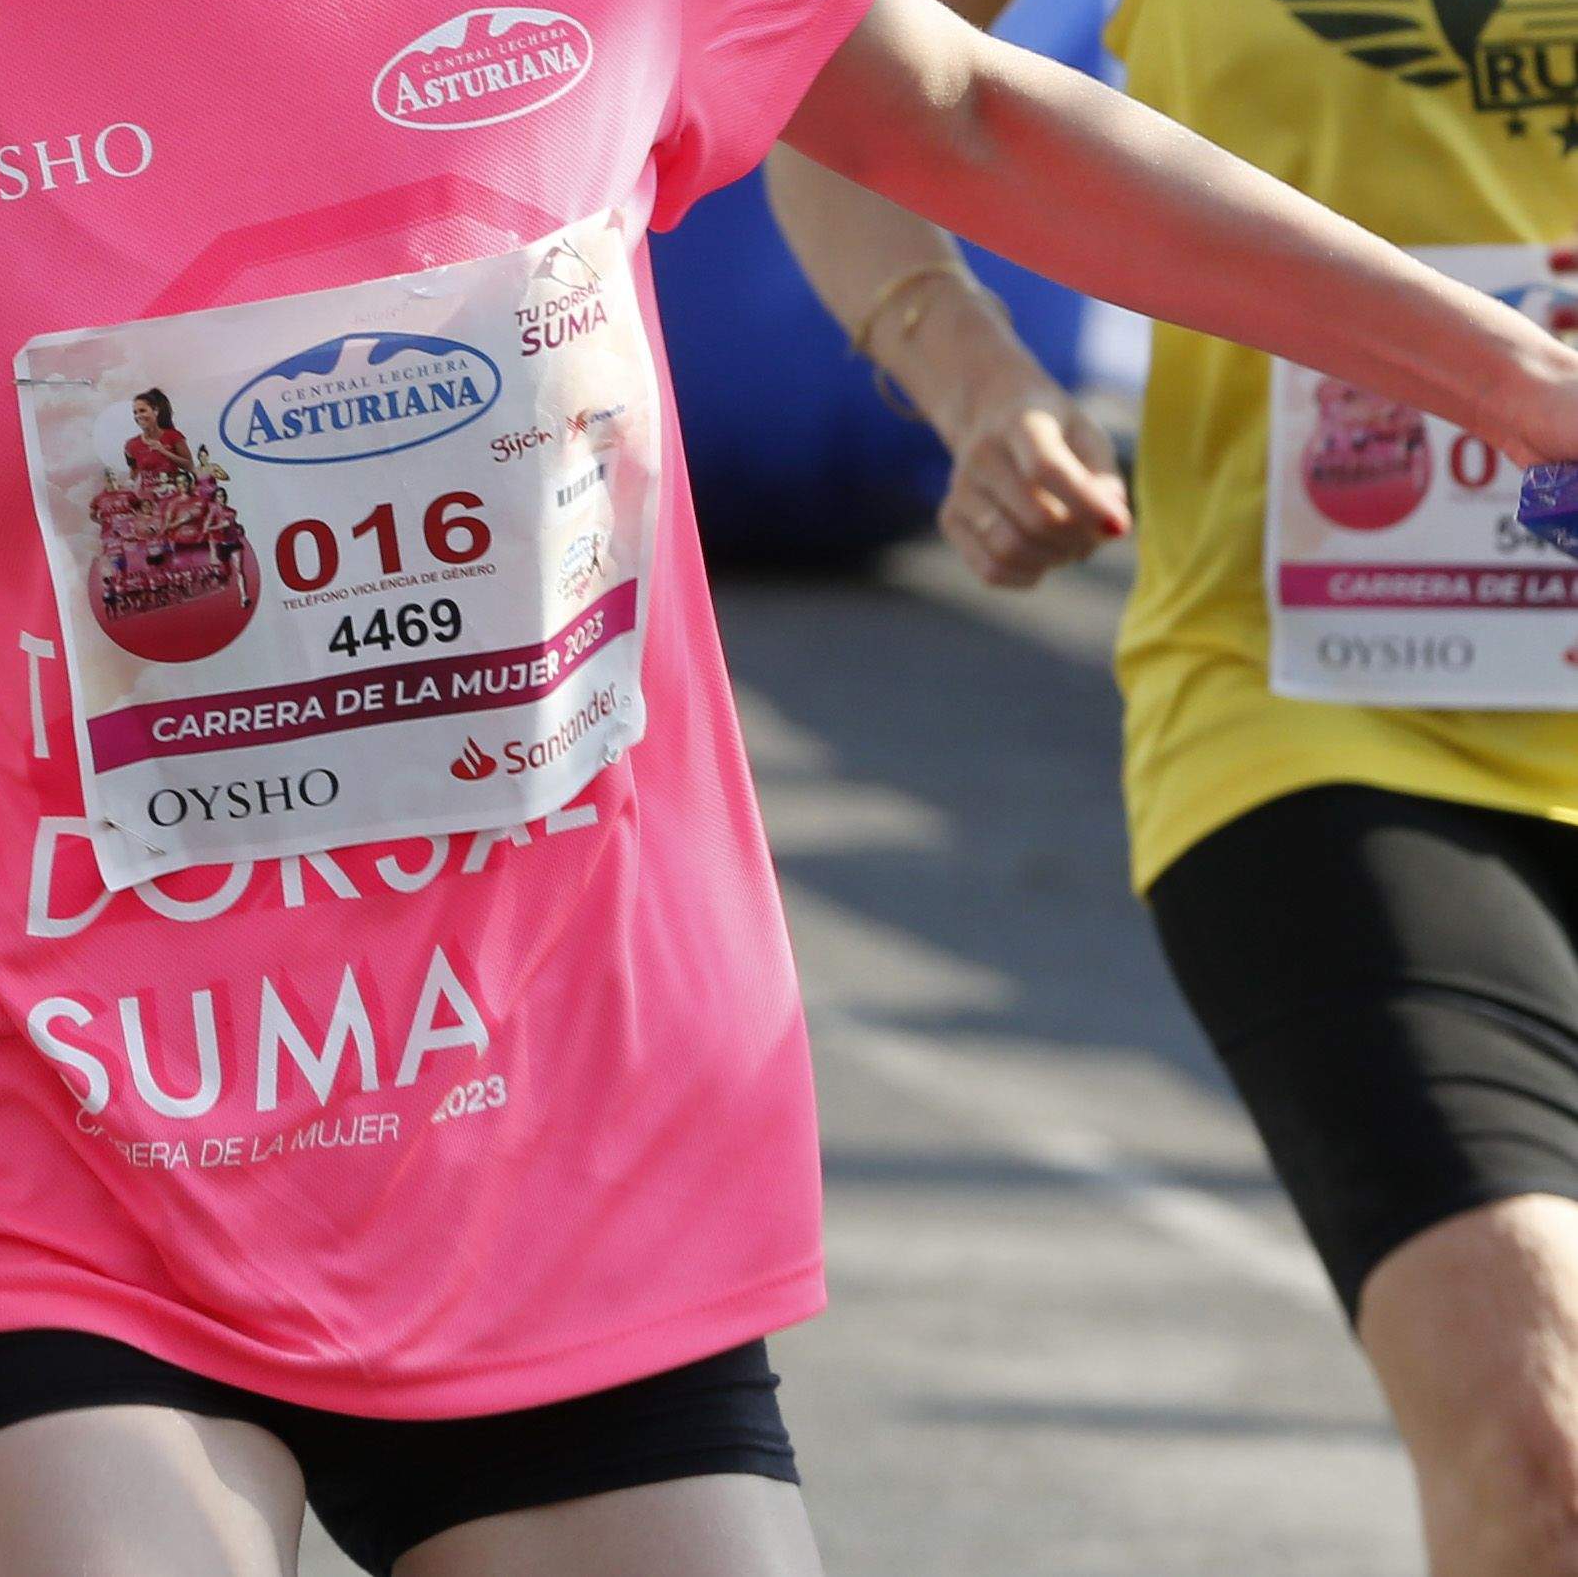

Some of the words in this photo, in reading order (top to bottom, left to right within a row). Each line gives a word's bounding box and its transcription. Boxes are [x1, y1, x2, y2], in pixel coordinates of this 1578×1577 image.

[392, 41, 582, 117] ASTURIANA
[420, 45, 494, 75] CENTRAL
[498, 26, 569, 56] LECHERA
[515, 305, 539, 326] TU
[521, 300, 609, 357] SUMA
[244, 376, 484, 447] ASTURIANA
[280, 377, 371, 404] CENTRAL
[377, 358, 470, 386] LECHERA
[275, 491, 492, 593] 016
[282, 586, 349, 611] TELÉFONO
[351, 575, 419, 598] VIOLENCIA
[421, 571, 439, 584] DE
[328, 597, 462, 657] 4469
[152, 698, 326, 743] CARRERA
[334, 683, 384, 716] DE
[395, 673, 442, 707] LA
[451, 650, 560, 698] MUJER
[503, 681, 618, 775] Santander
[148, 767, 340, 828] OYSHO
[26, 943, 489, 1119] SUMA
[199, 1135, 244, 1167] DE
[249, 1133, 285, 1164] LA
[290, 1112, 400, 1152] MUJER
[430, 1074, 507, 1123] 023
